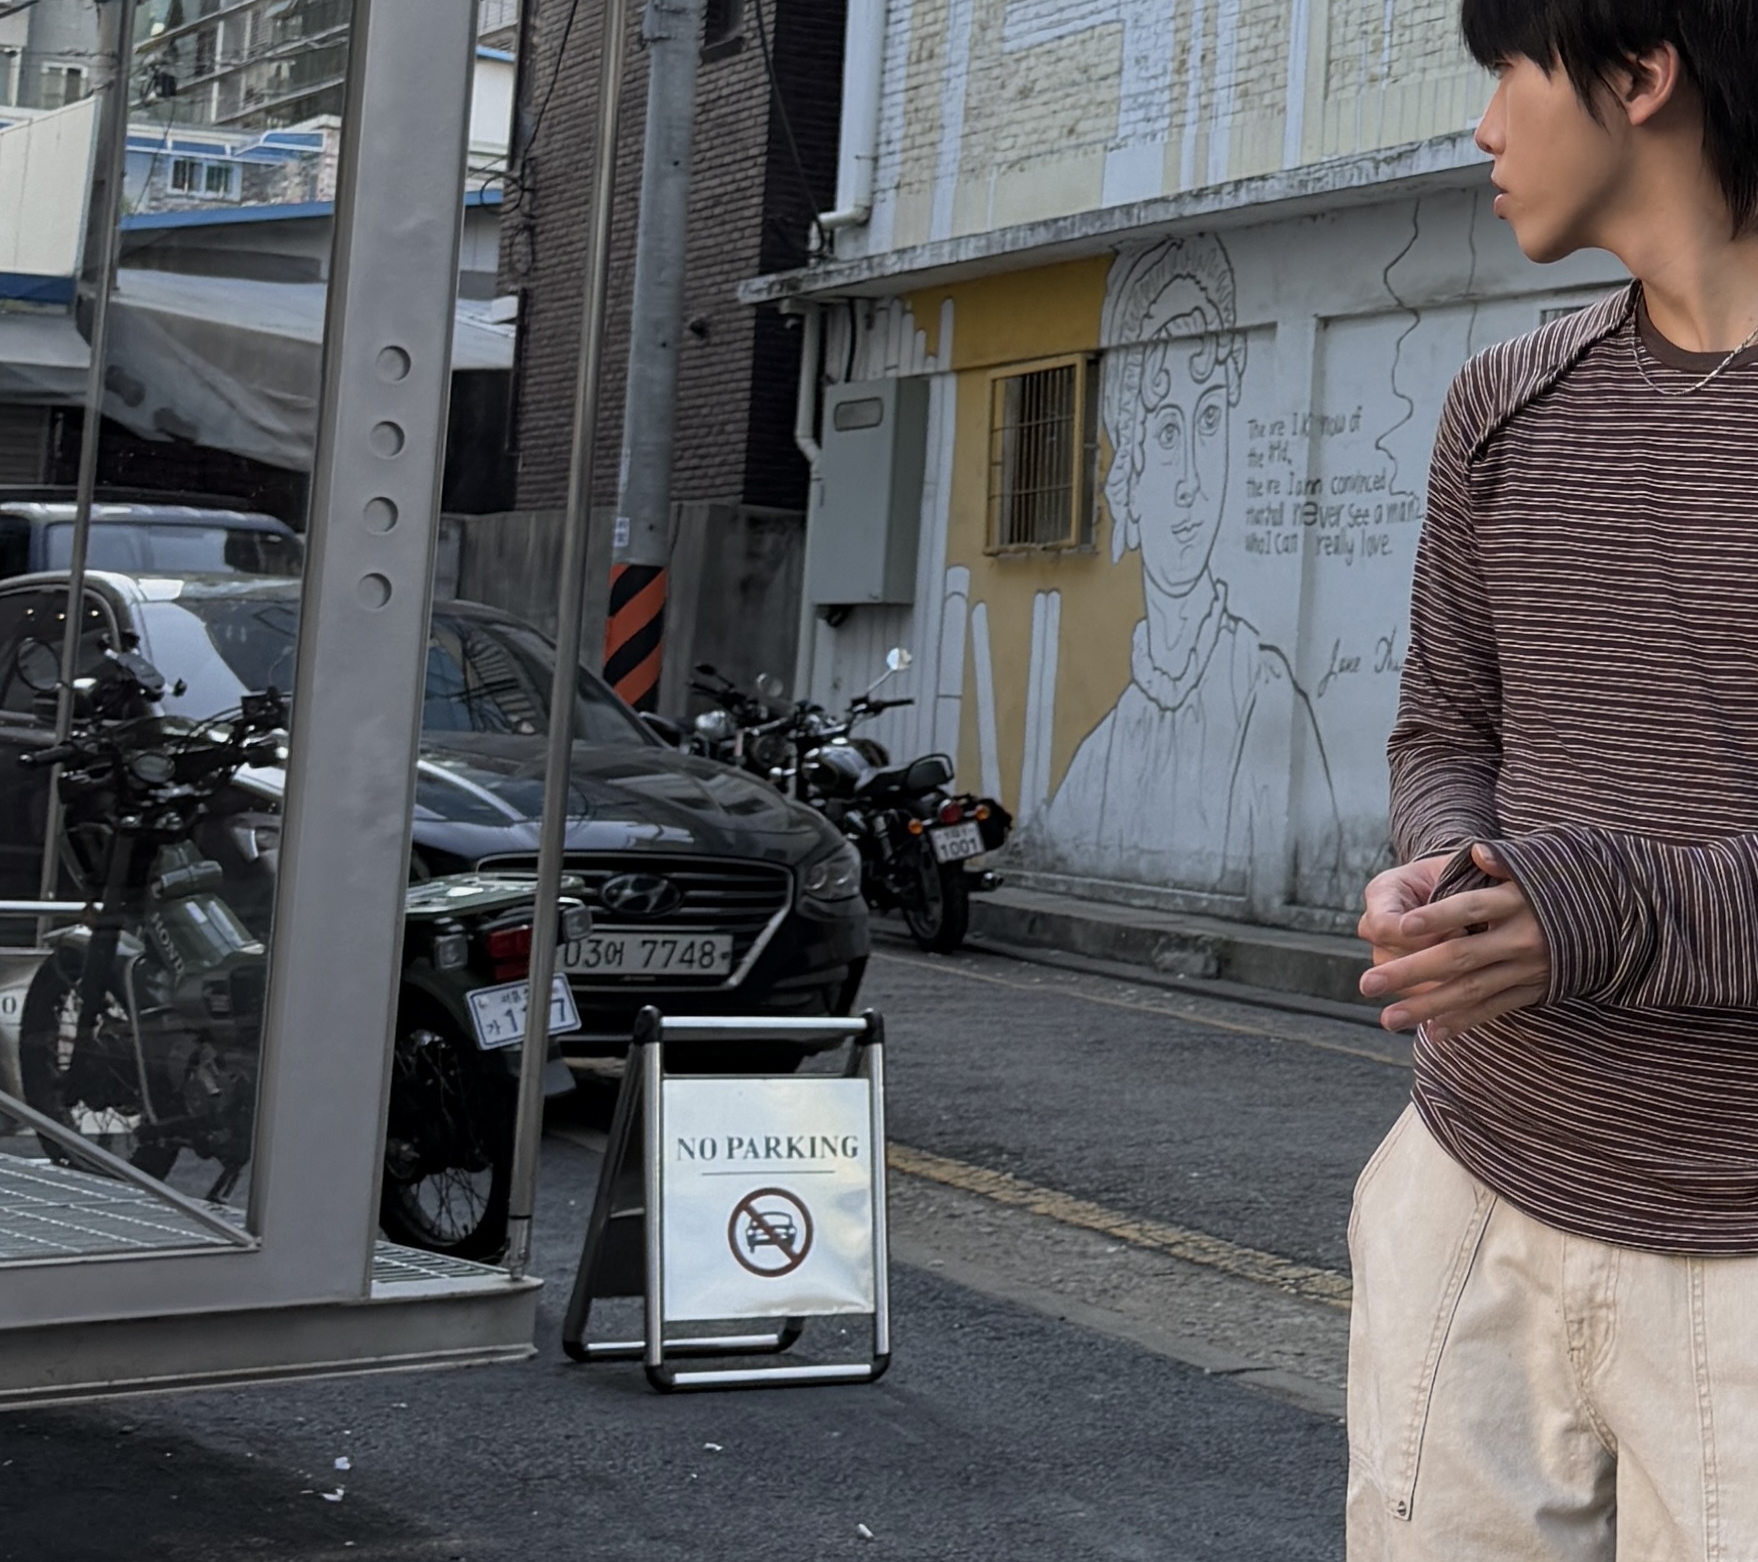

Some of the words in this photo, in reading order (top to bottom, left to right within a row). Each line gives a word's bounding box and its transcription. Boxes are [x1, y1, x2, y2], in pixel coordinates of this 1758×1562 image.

[940, 838, 977, 858] 1001
[641, 940, 716, 969] 7748
[676, 1136, 718, 1161] NO
[725, 1134, 860, 1161] PARKING
